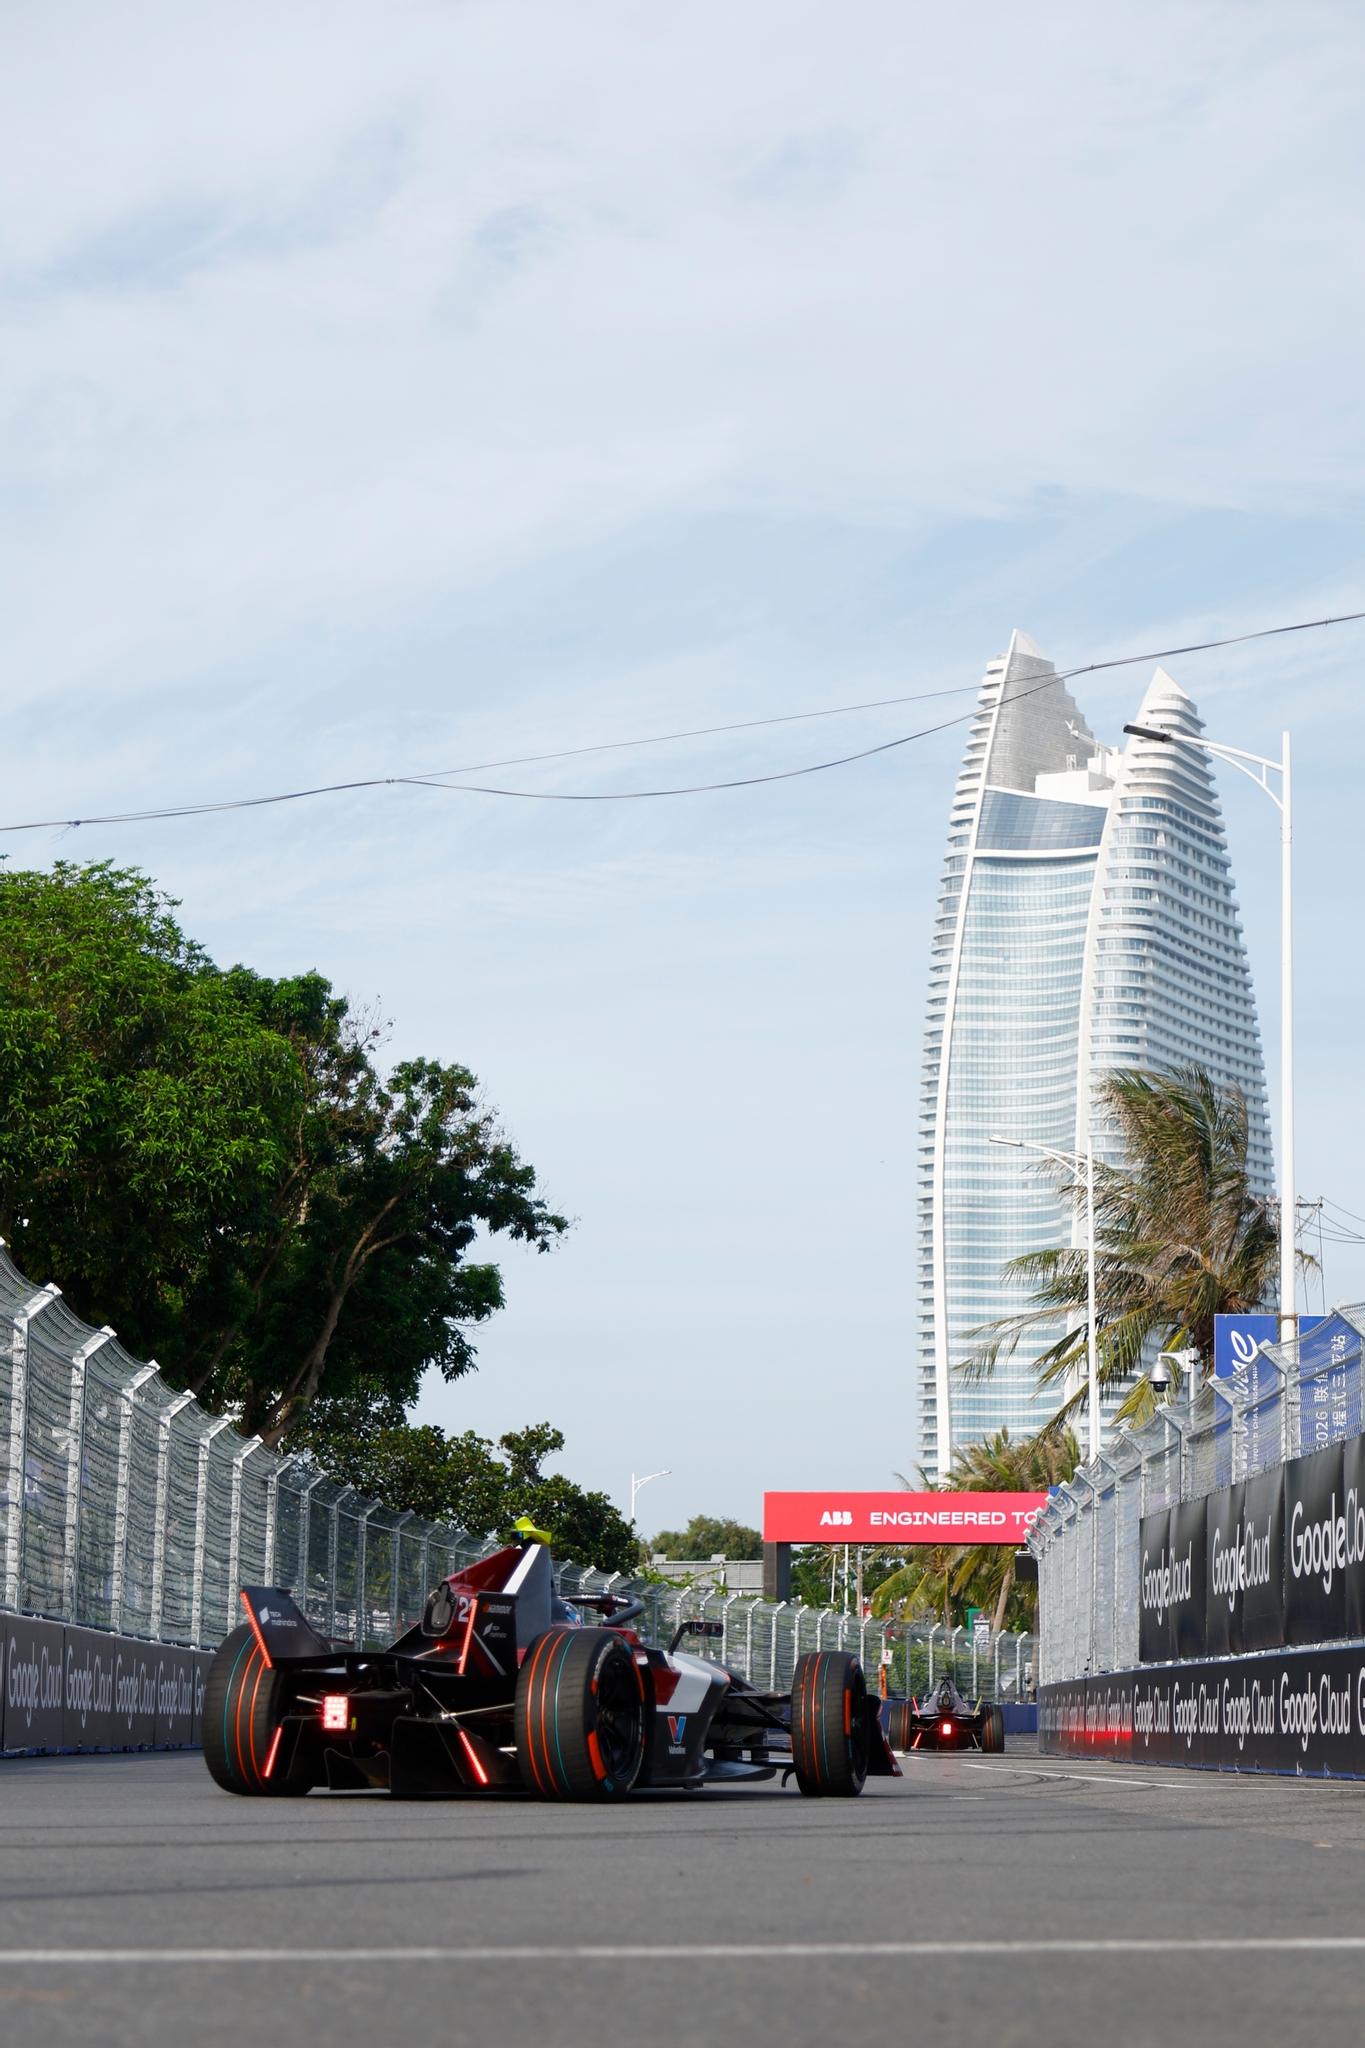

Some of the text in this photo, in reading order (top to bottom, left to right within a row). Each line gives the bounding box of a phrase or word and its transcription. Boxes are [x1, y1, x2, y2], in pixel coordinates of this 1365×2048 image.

[820, 1511, 853, 1525] ABB
[870, 1511, 1006, 1525] ENGINEERED
[1291, 1492, 1345, 1594] Google
[1142, 1540, 1192, 1626] Google Cloud
[1212, 1515, 1272, 1612] Google Cloud
[9, 1636, 39, 1728] Google
[41, 1645, 62, 1709] Cloud
[66, 1644, 92, 1729] Google
[94, 1654, 113, 1713] Cloud
[116, 1653, 157, 1730] Google Cloud
[158, 1660, 193, 1730] Google Cloud
[1134, 1684, 1153, 1747] Google
[1154, 1686, 1170, 1733] Cloud
[1173, 1681, 1219, 1749] Google Cloud
[1222, 1678, 1275, 1751] Google Cloud
[1280, 1671, 1350, 1752] Google Cloud
